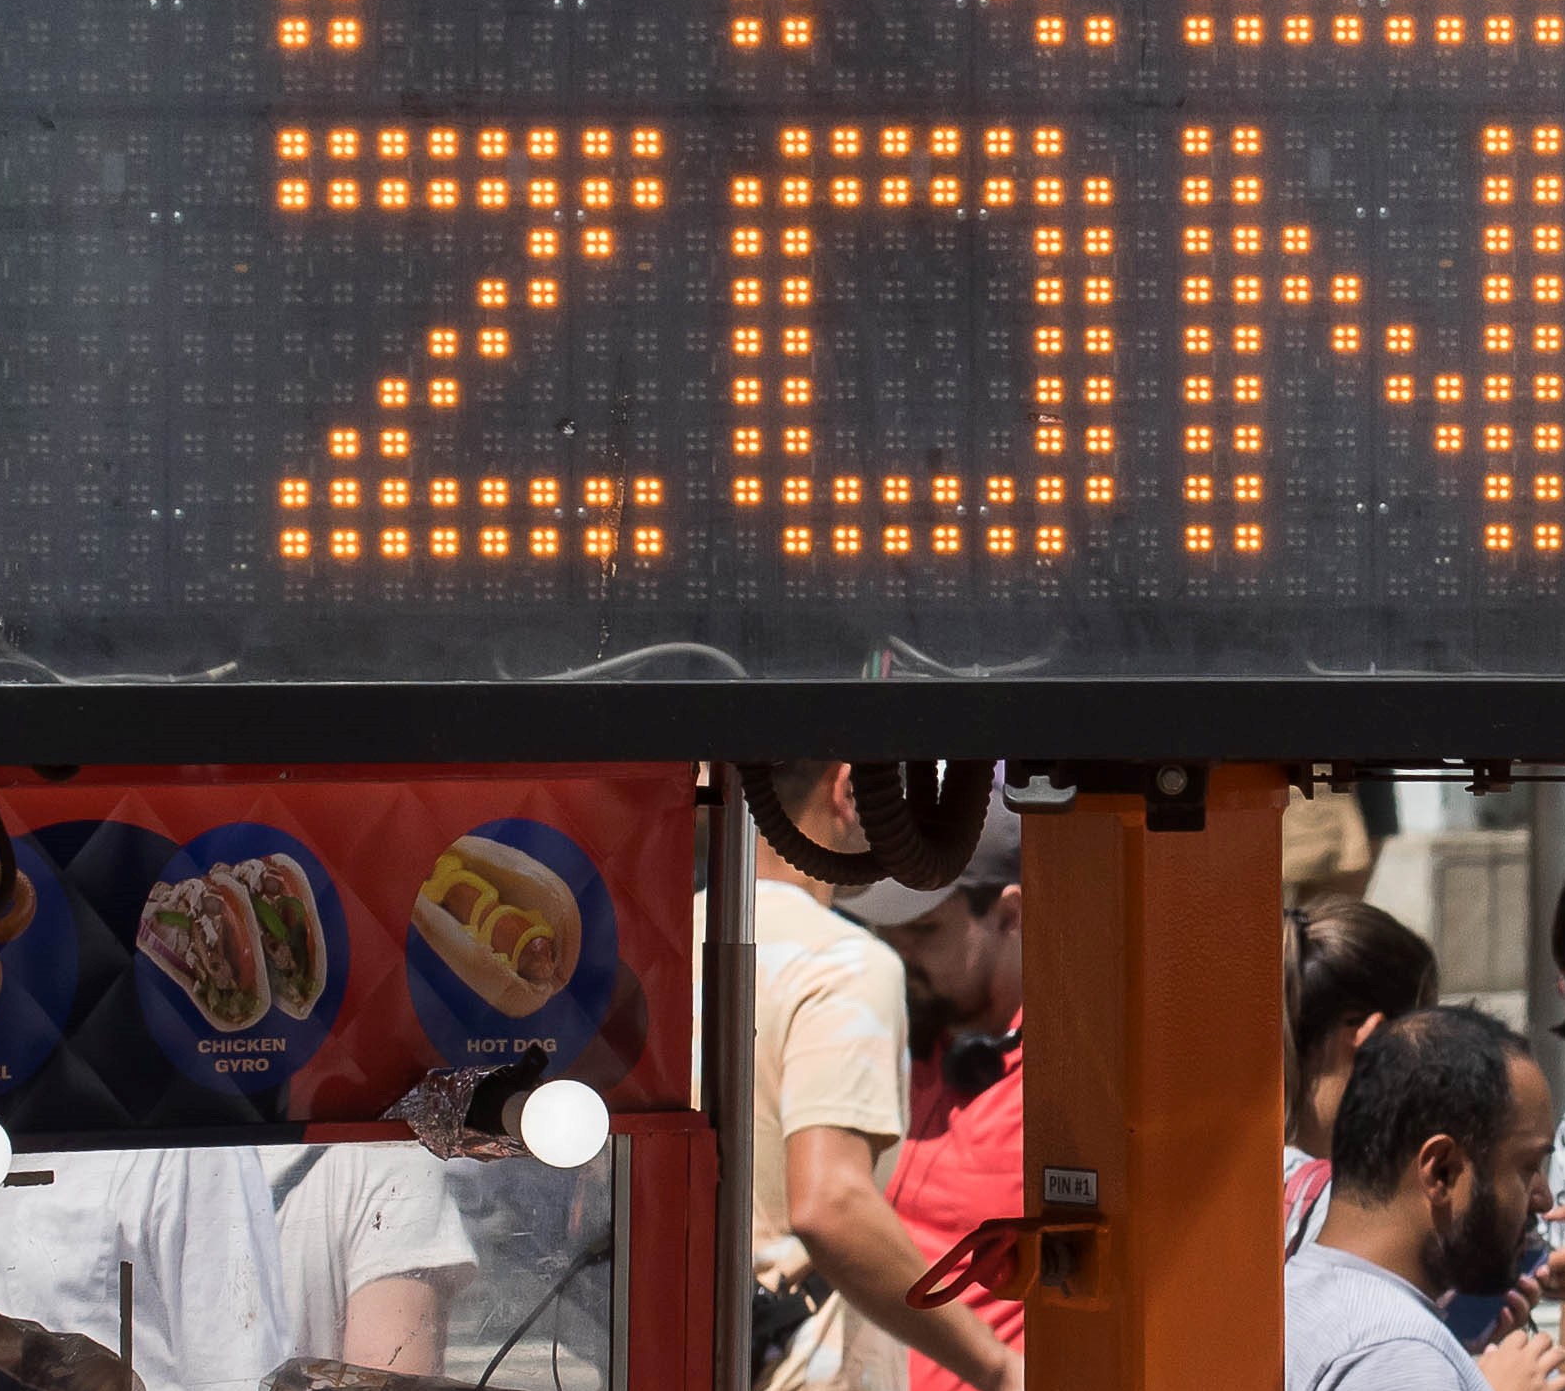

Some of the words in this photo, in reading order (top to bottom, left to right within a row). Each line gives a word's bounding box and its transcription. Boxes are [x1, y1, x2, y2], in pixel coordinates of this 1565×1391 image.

[197, 1038, 287, 1055] CHICKEN
[466, 1038, 508, 1053] HOT
[214, 1057, 269, 1074] GYRO
[1049, 1175, 1071, 1195] PIN
